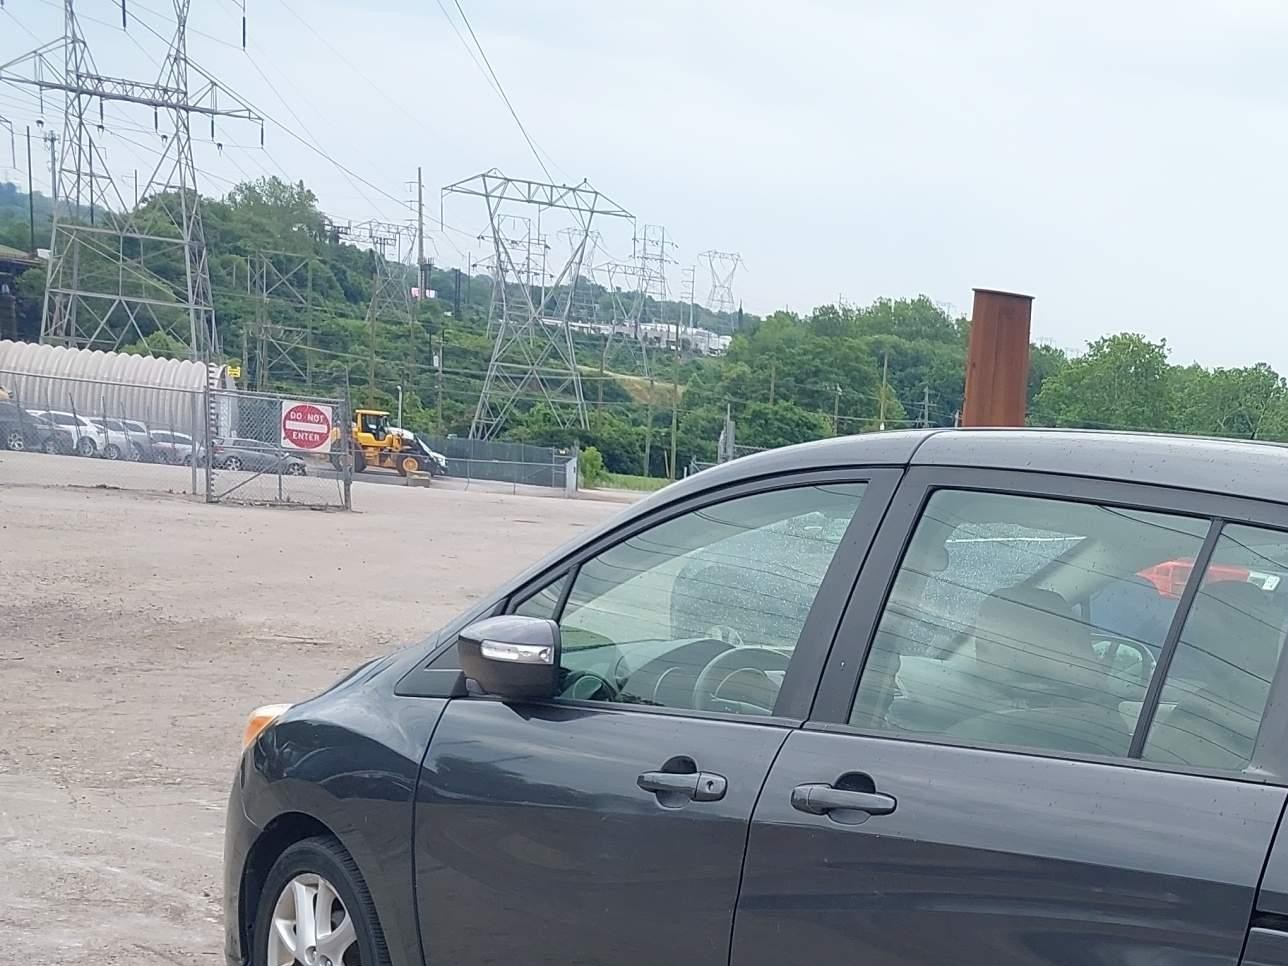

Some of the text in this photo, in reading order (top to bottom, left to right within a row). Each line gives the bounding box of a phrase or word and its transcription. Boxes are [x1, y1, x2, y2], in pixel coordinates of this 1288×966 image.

[290, 411, 325, 423] DO NOT
[292, 431, 320, 441] ENTER
